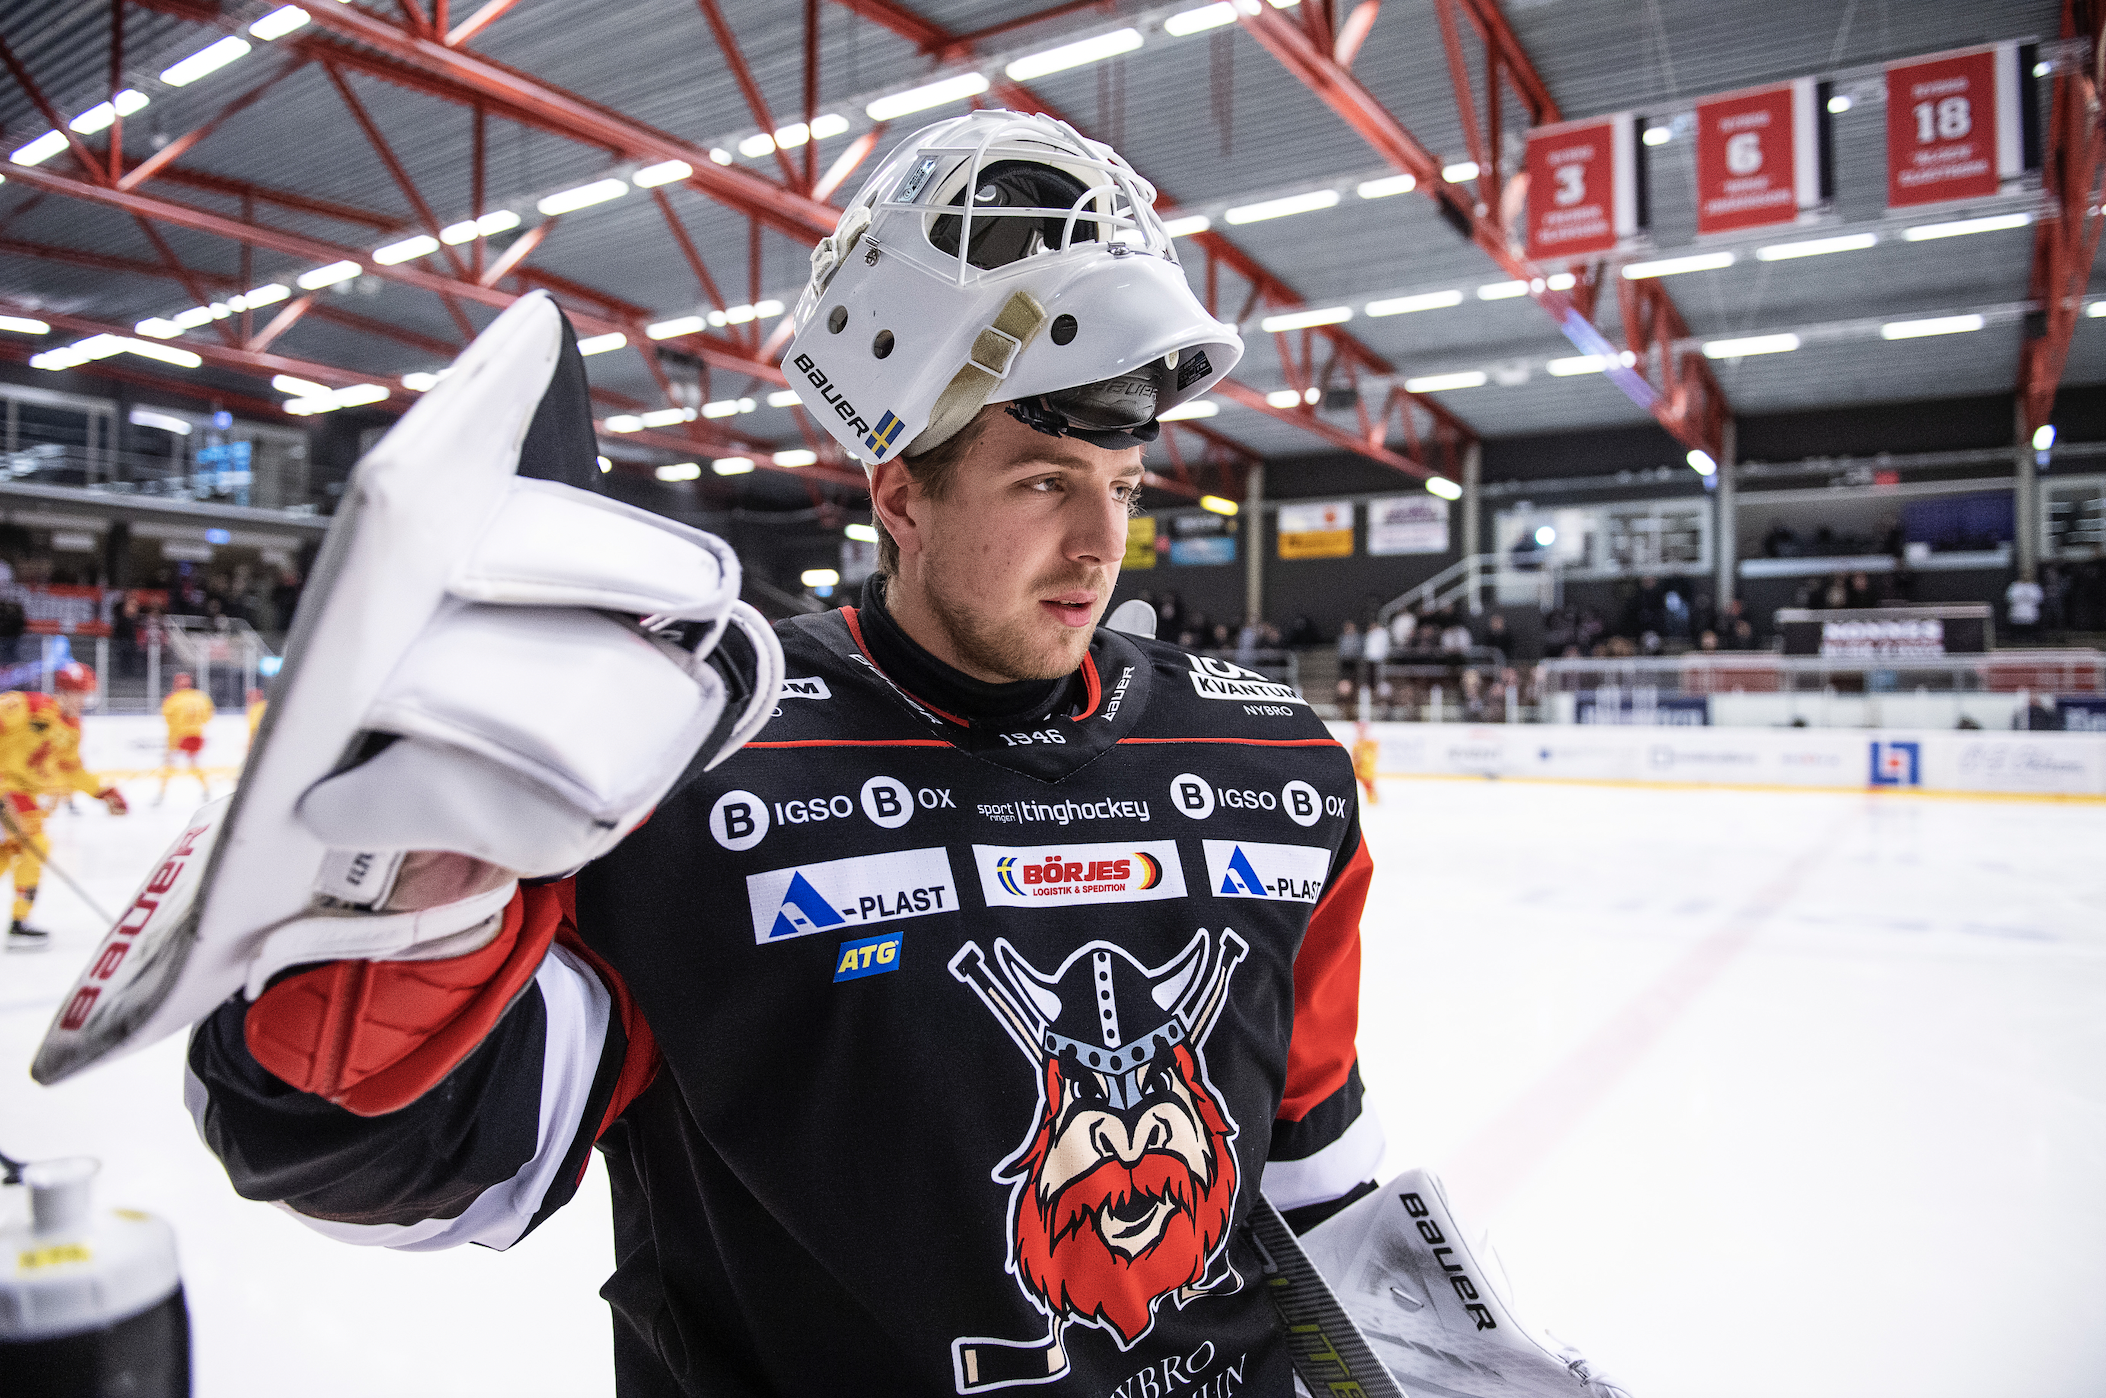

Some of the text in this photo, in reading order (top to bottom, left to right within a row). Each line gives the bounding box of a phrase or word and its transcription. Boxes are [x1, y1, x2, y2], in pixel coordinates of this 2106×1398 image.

[1912, 97, 1972, 145] 18
[1725, 132, 1763, 175] 6
[1554, 164, 1586, 206] 3
[1197, 675, 1302, 700] KVANTUM
[1243, 704, 1294, 717] NYBRO
[999, 728, 1067, 746] 1946
[977, 802, 1013, 817] sport
[990, 814, 1016, 824] ringen
[1023, 855, 1131, 885] BÖRJES
[1033, 883, 1126, 896] LOGISTIK & SPEDITION
[837, 940, 897, 973] ATG
[1110, 1340, 1215, 1398] YBRO
